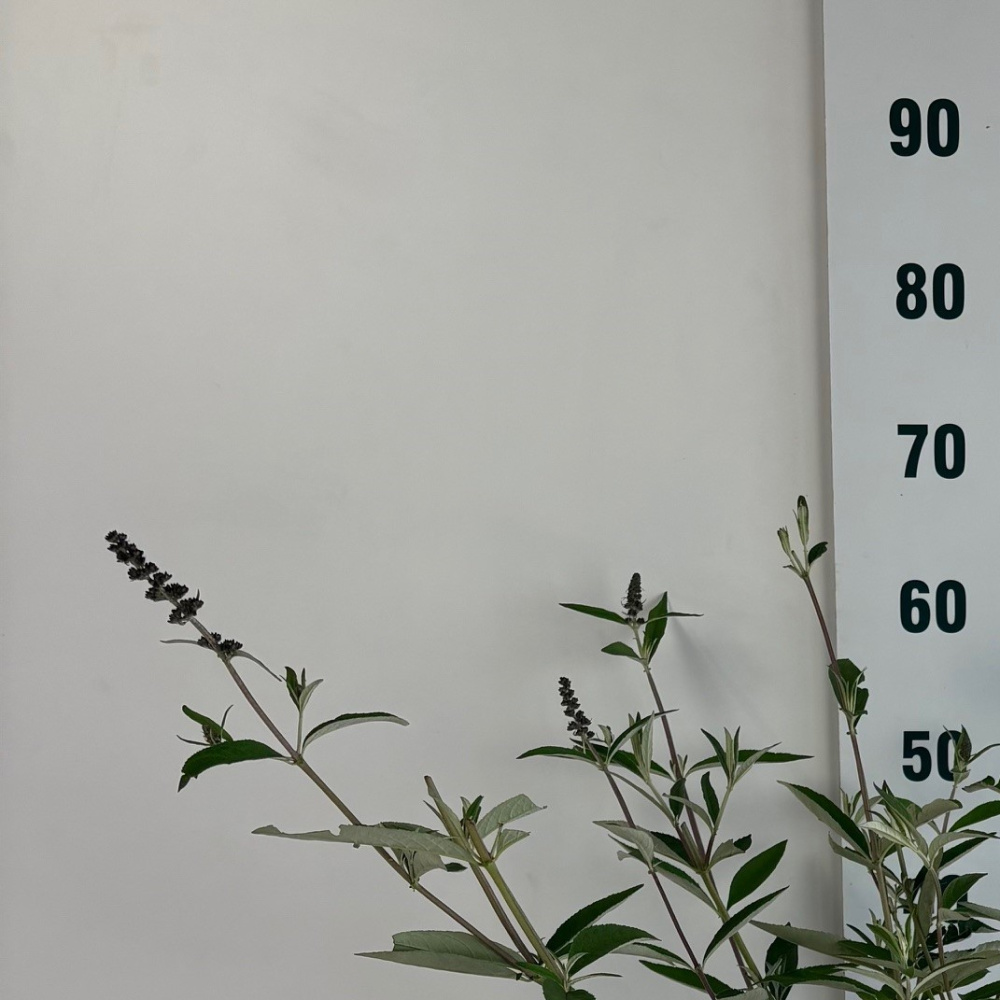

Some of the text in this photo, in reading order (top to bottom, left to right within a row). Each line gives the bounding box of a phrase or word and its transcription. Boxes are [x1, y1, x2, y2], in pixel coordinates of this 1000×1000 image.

[889, 98, 960, 157] 90
[895, 263, 966, 320] 80
[897, 423, 967, 480] 70
[899, 580, 967, 634] 60
[902, 730, 964, 782] 50
